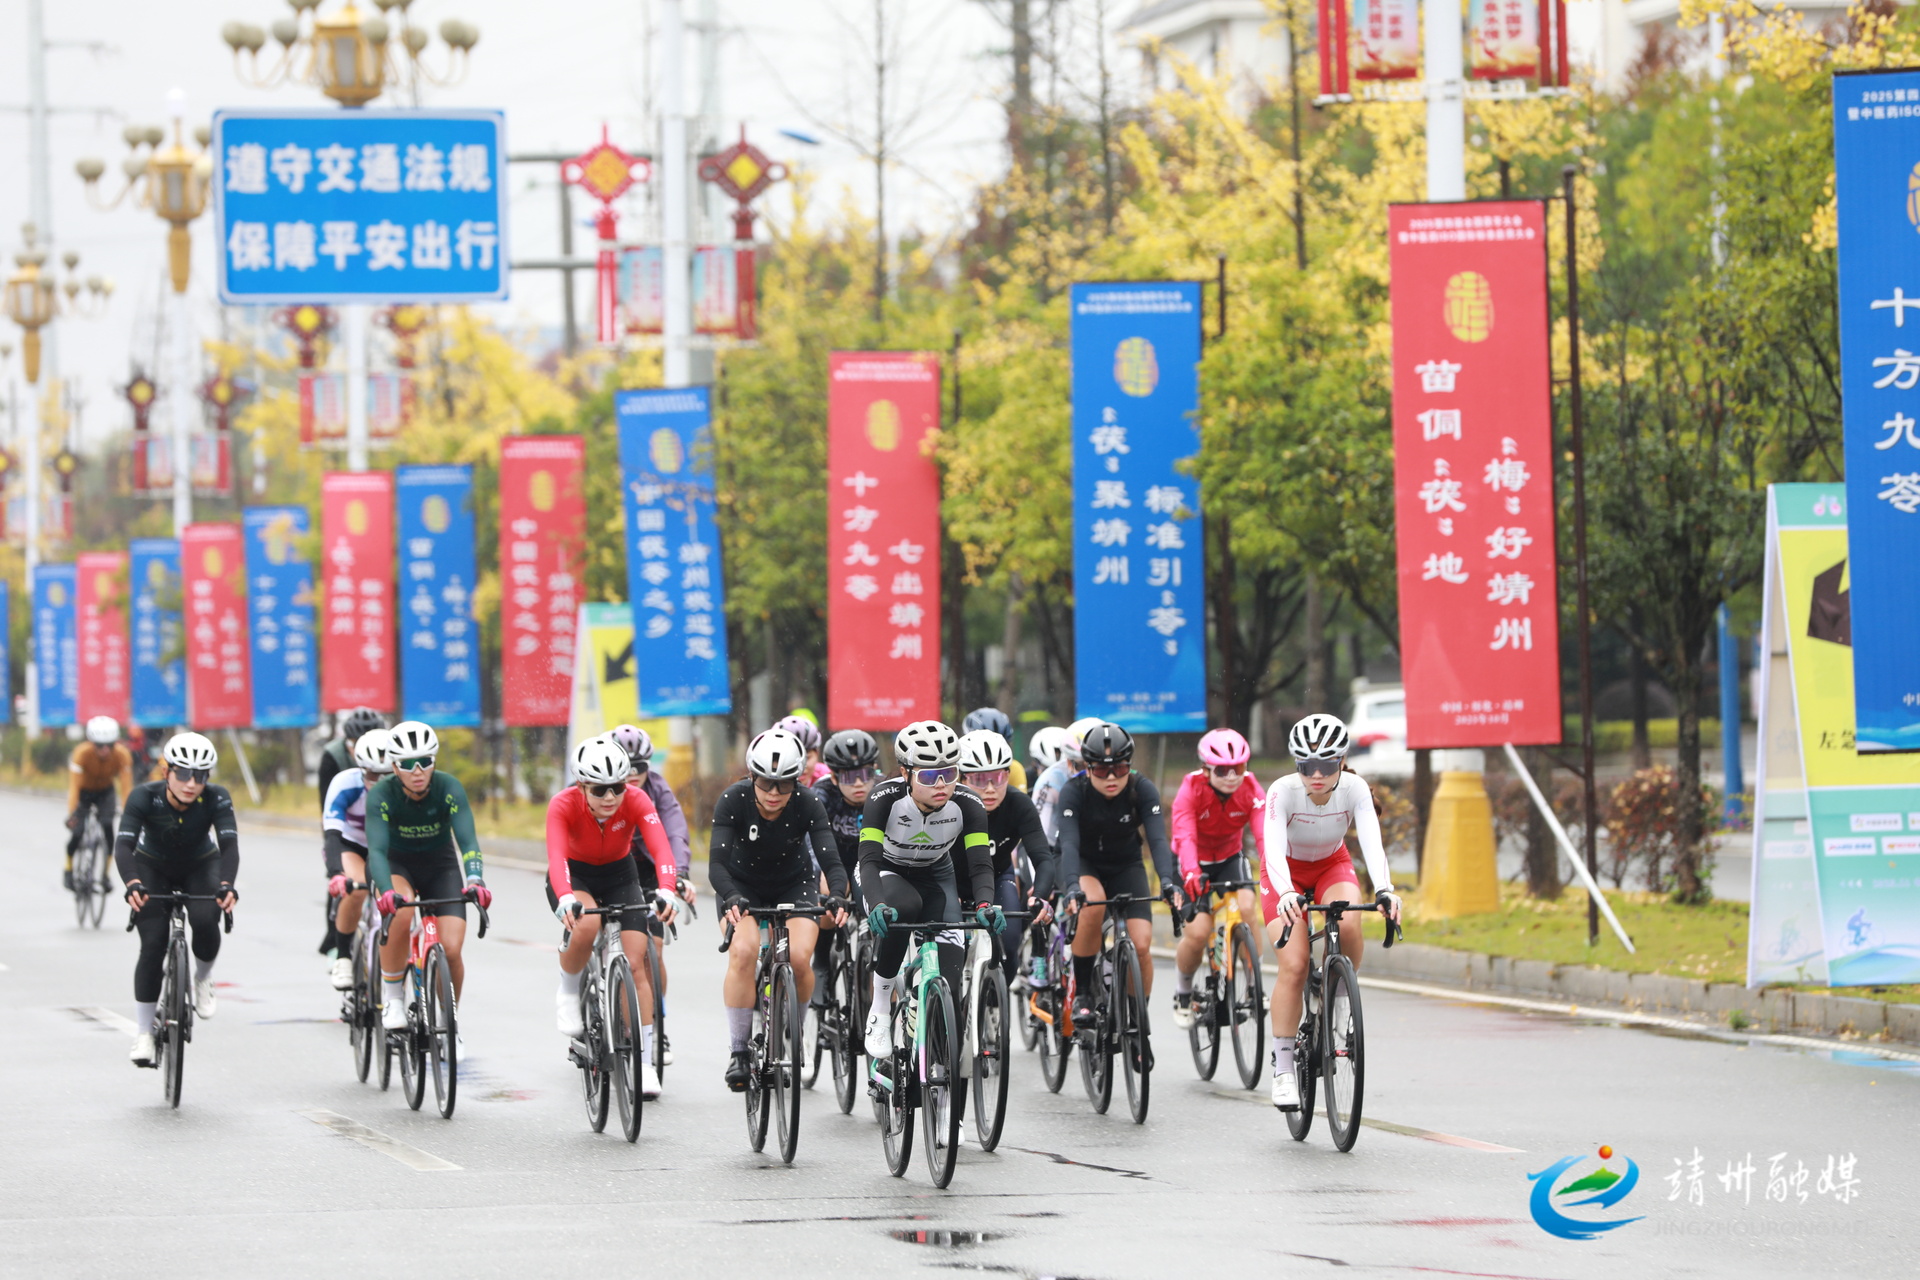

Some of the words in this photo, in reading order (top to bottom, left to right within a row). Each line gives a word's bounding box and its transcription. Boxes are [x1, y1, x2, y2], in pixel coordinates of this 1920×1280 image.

[226, 143, 492, 194] 遵守交通法规
[228, 219, 498, 272] 保障平安出行
[1870, 287, 1920, 513] 十方九苓
[842, 471, 879, 600] 十方九苓
[870, 786, 900, 802] Santic
